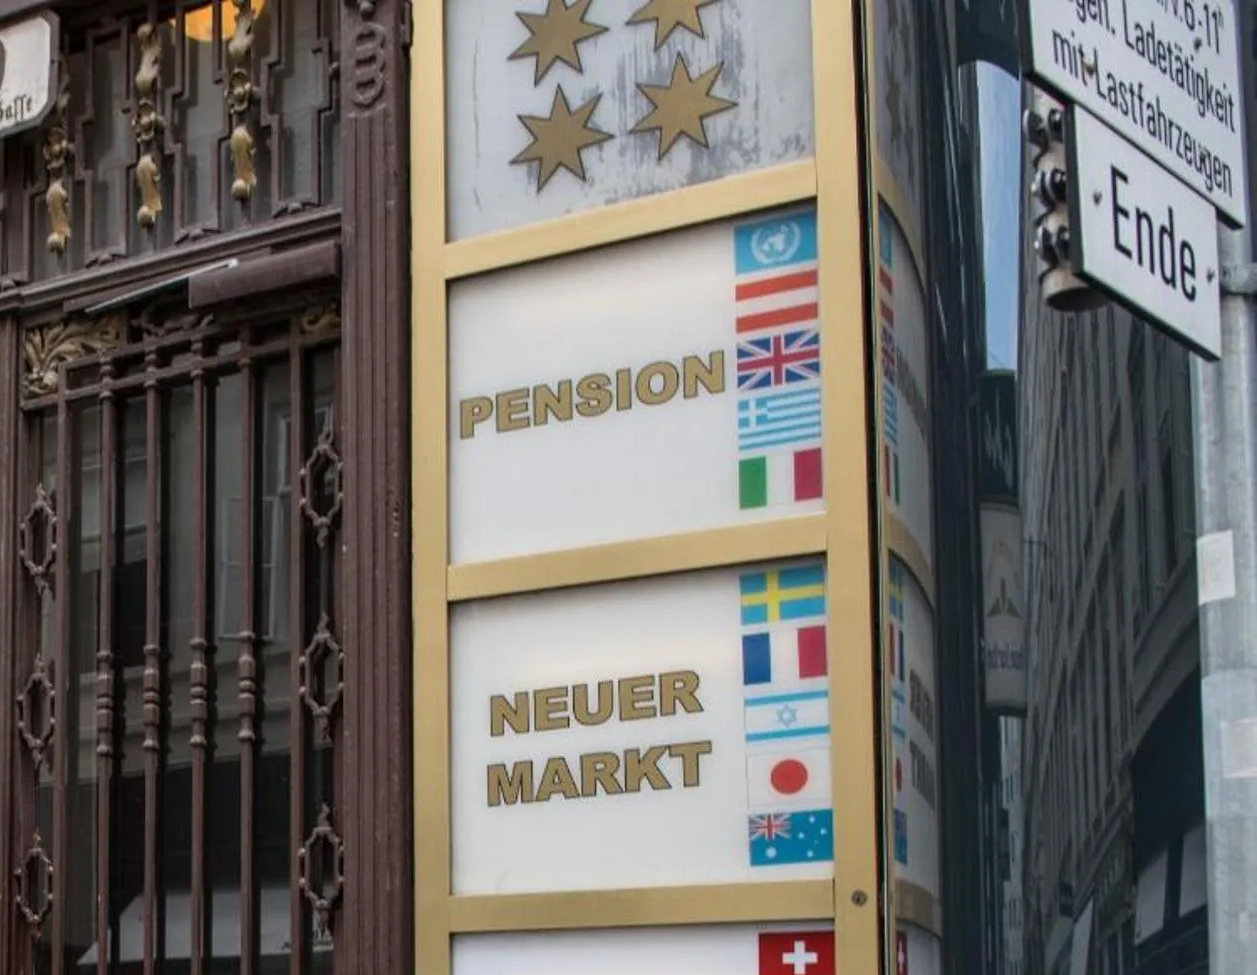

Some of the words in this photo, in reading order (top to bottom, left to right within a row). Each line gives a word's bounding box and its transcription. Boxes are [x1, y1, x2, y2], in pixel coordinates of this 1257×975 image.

[1052, 29, 1087, 87] mit
[1093, 48, 1233, 198] Lastfahrzeugen
[1122, 0, 1236, 133] Ladetätigkeit
[1110, 164, 1197, 303] Ende
[459, 349, 726, 440] PENSION
[490, 670, 704, 737] NEUER
[486, 740, 712, 807] MARKT
